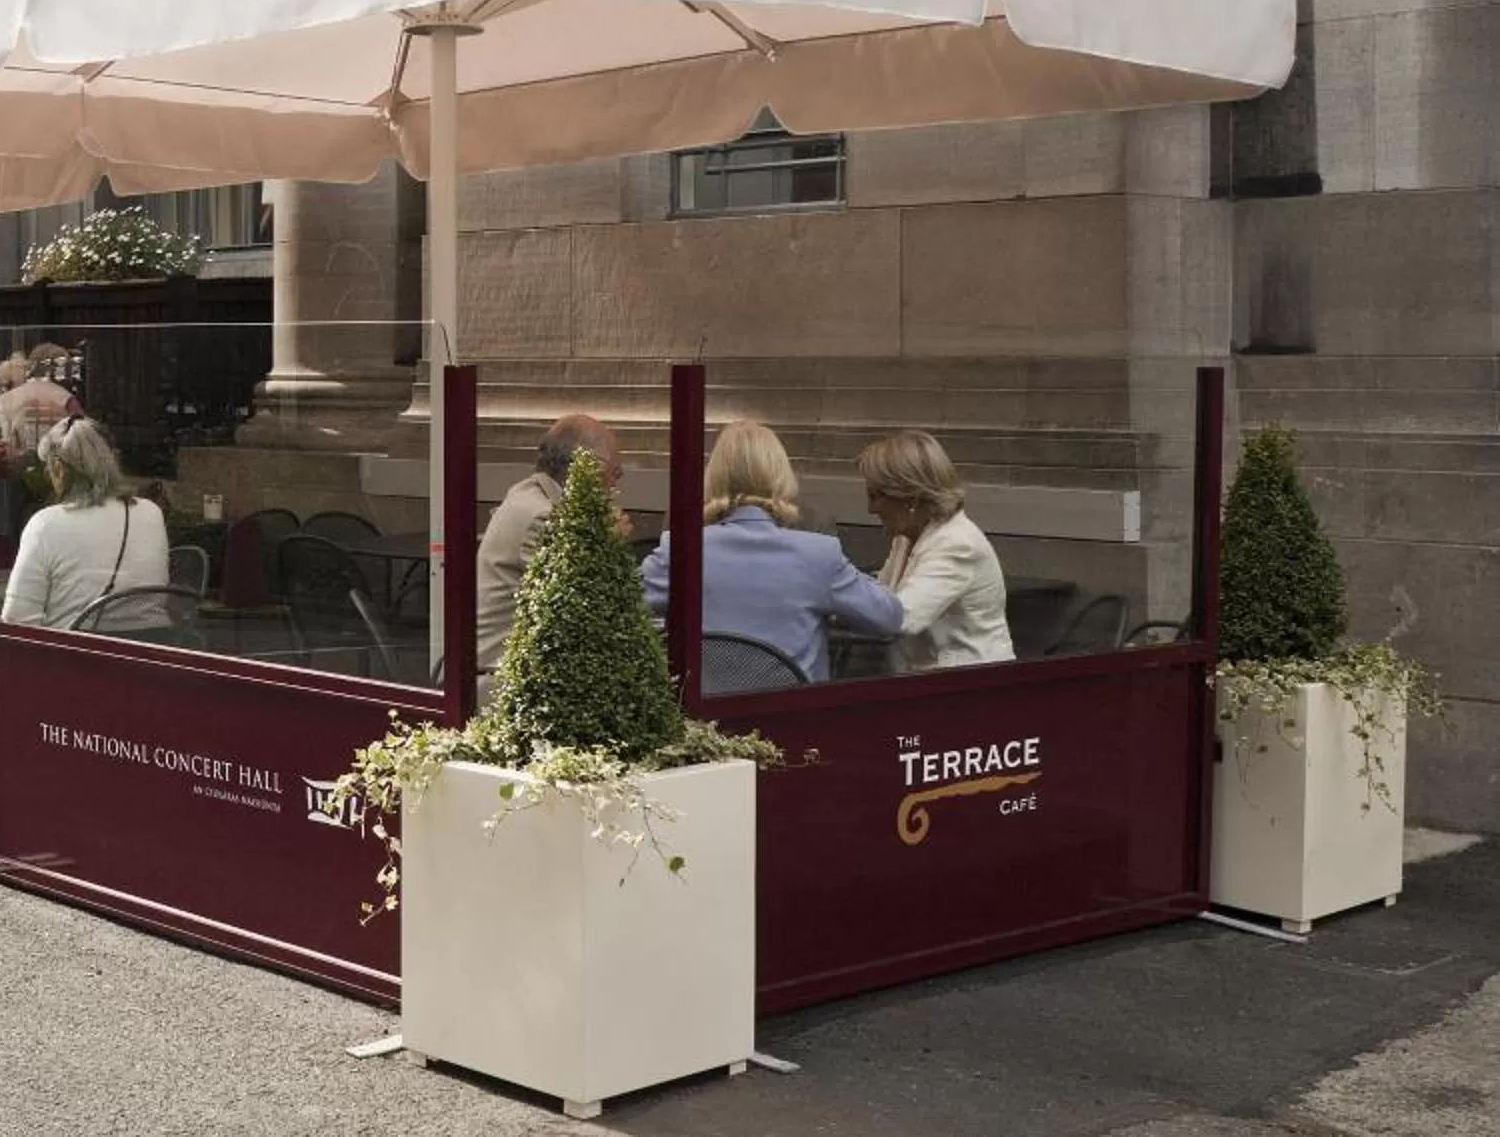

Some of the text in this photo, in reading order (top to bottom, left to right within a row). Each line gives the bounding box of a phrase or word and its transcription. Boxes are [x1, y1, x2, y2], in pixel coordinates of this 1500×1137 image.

[40, 722, 284, 794] THE NATIONAL CONCERT HALL
[896, 734, 921, 749] THE
[899, 736, 1041, 787] TERRACE
[999, 791, 1038, 816] CAFÉ
